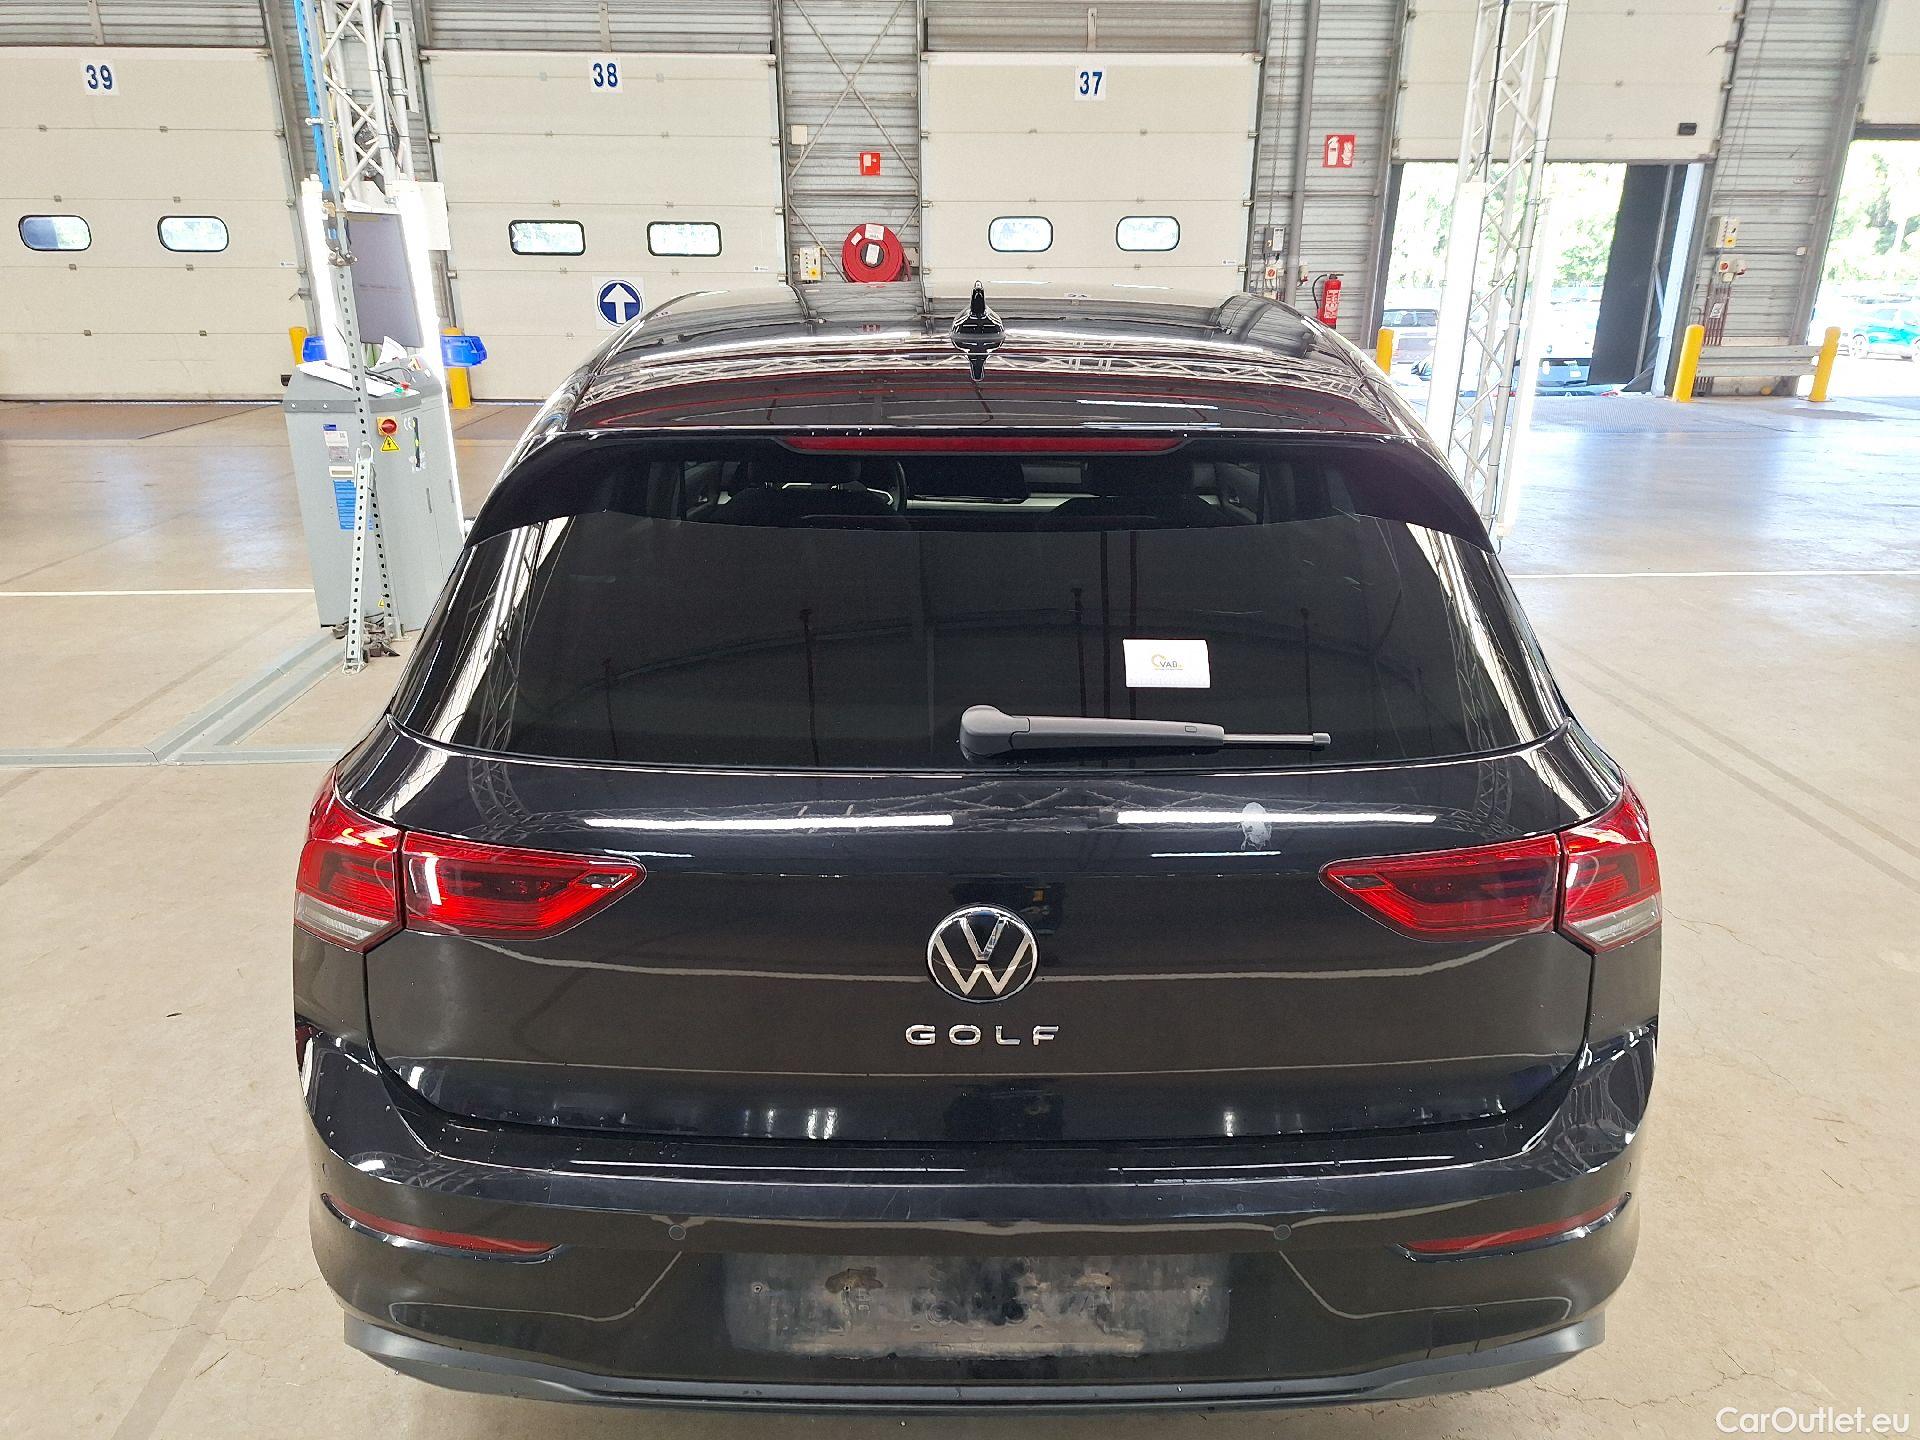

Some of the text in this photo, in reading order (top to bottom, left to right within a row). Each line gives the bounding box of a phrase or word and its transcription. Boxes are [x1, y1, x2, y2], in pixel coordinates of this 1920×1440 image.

[86, 64, 113, 90] 39
[593, 62, 618, 88] 38
[1079, 71, 1103, 95] 37
[905, 1024, 1060, 1046] GOLF
